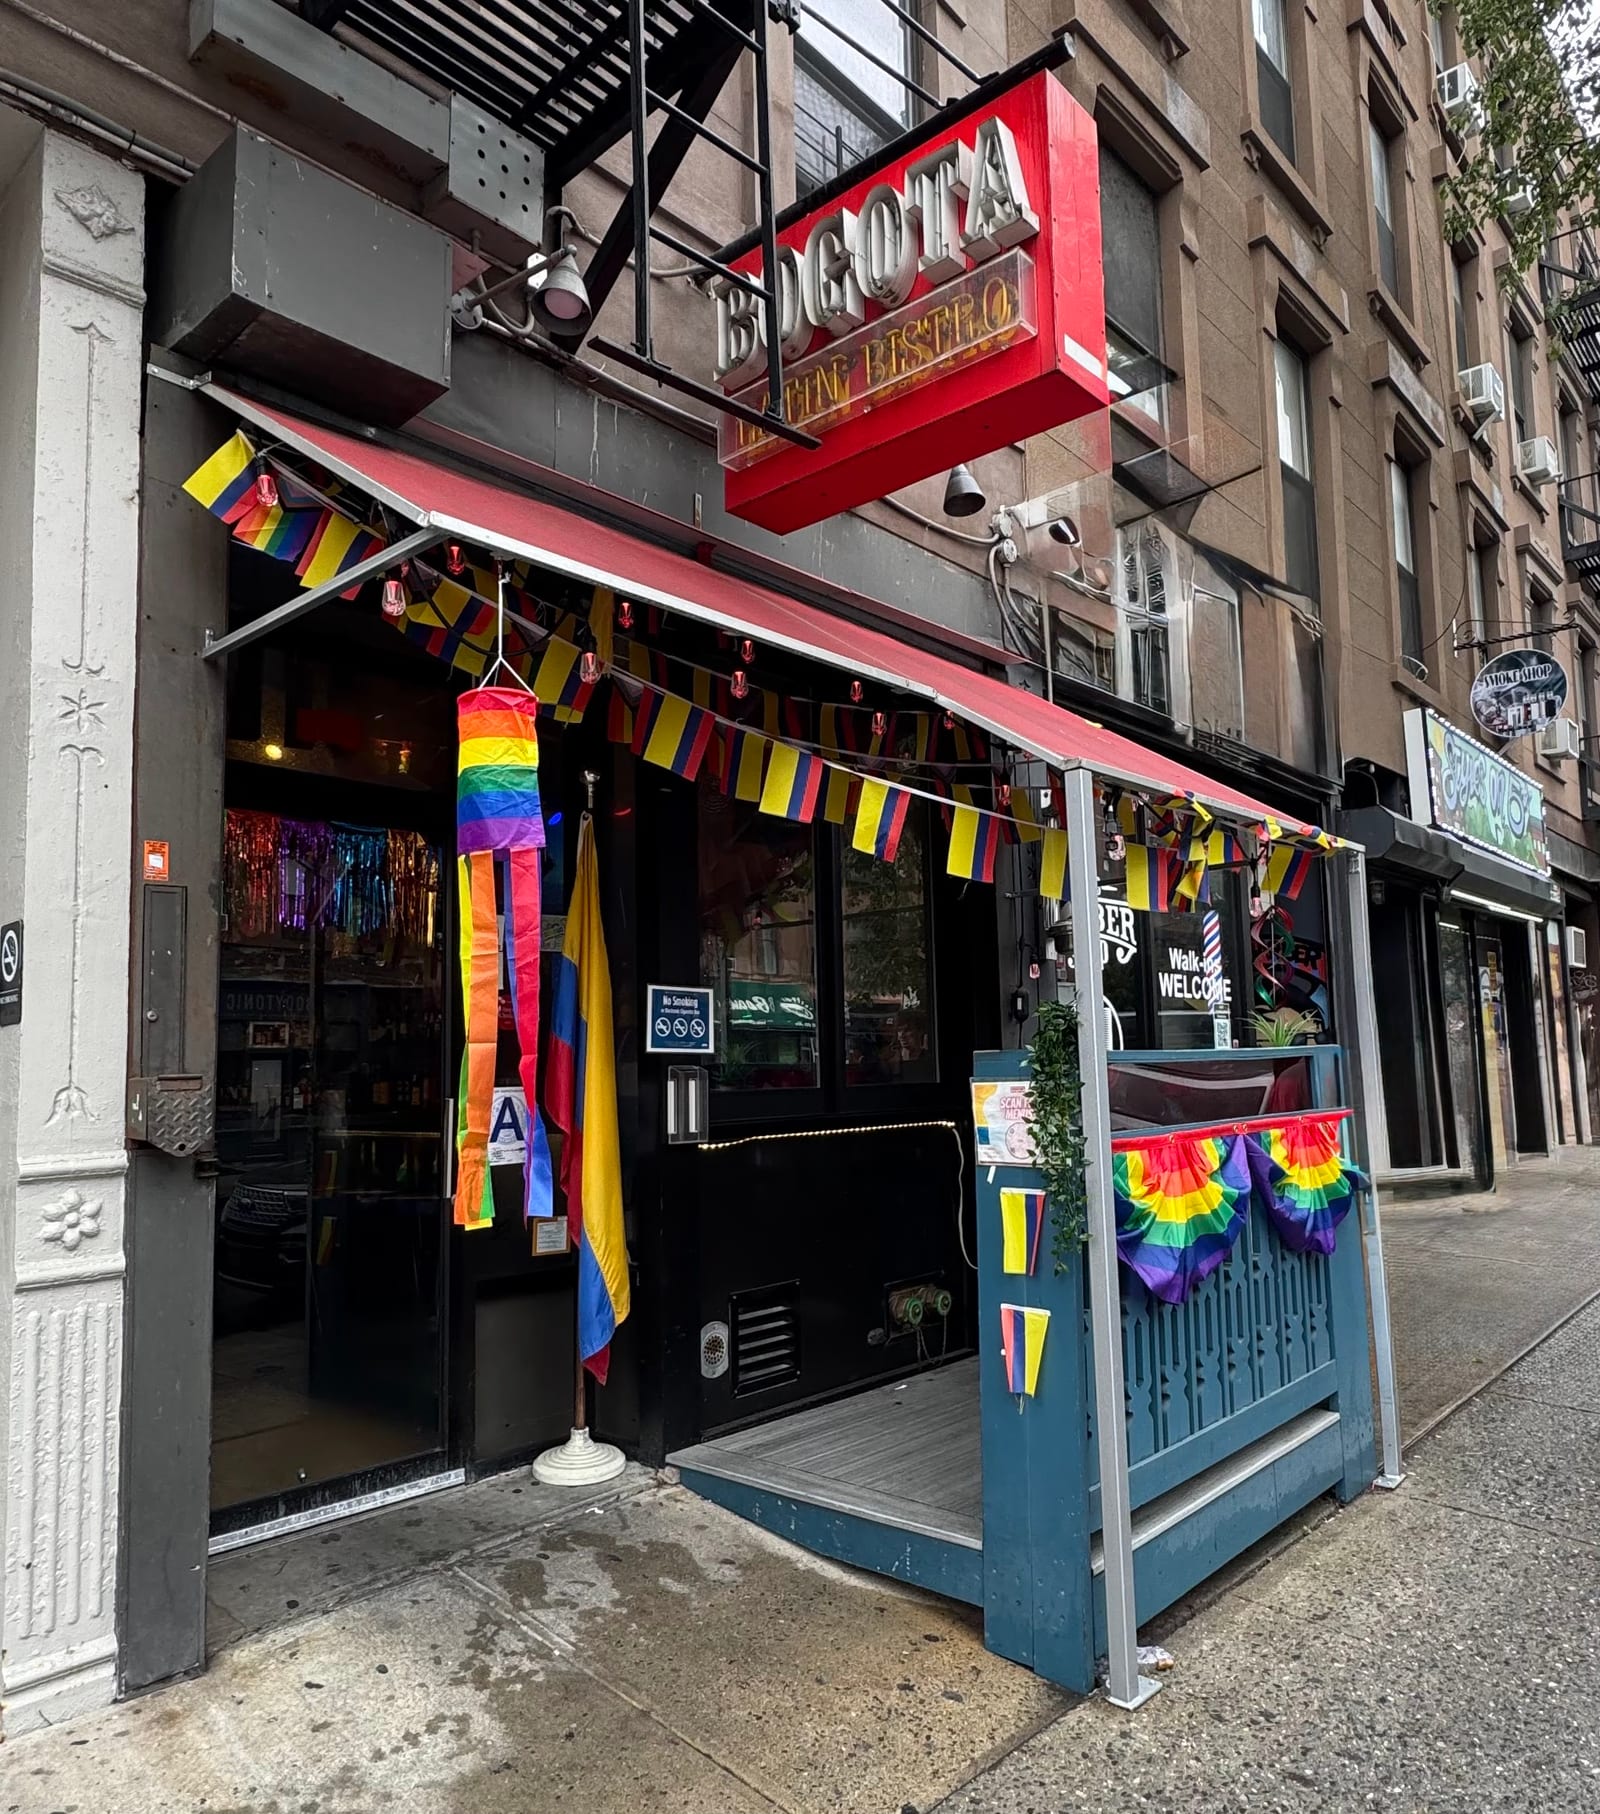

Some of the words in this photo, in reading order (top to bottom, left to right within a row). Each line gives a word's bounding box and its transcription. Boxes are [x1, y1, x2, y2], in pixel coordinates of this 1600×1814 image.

[713, 116, 1040, 390] BOGOTA
[861, 278, 1018, 390] BISTRO
[1484, 669, 1521, 688] SMOKE
[1521, 664, 1552, 682] SHOP
[663, 995, 671, 1006] No
[672, 995, 698, 1009] Smoking
[1158, 971, 1232, 1002] WELCOME
[1001, 1096, 1022, 1109] SCAN
[490, 1097, 525, 1143] A
